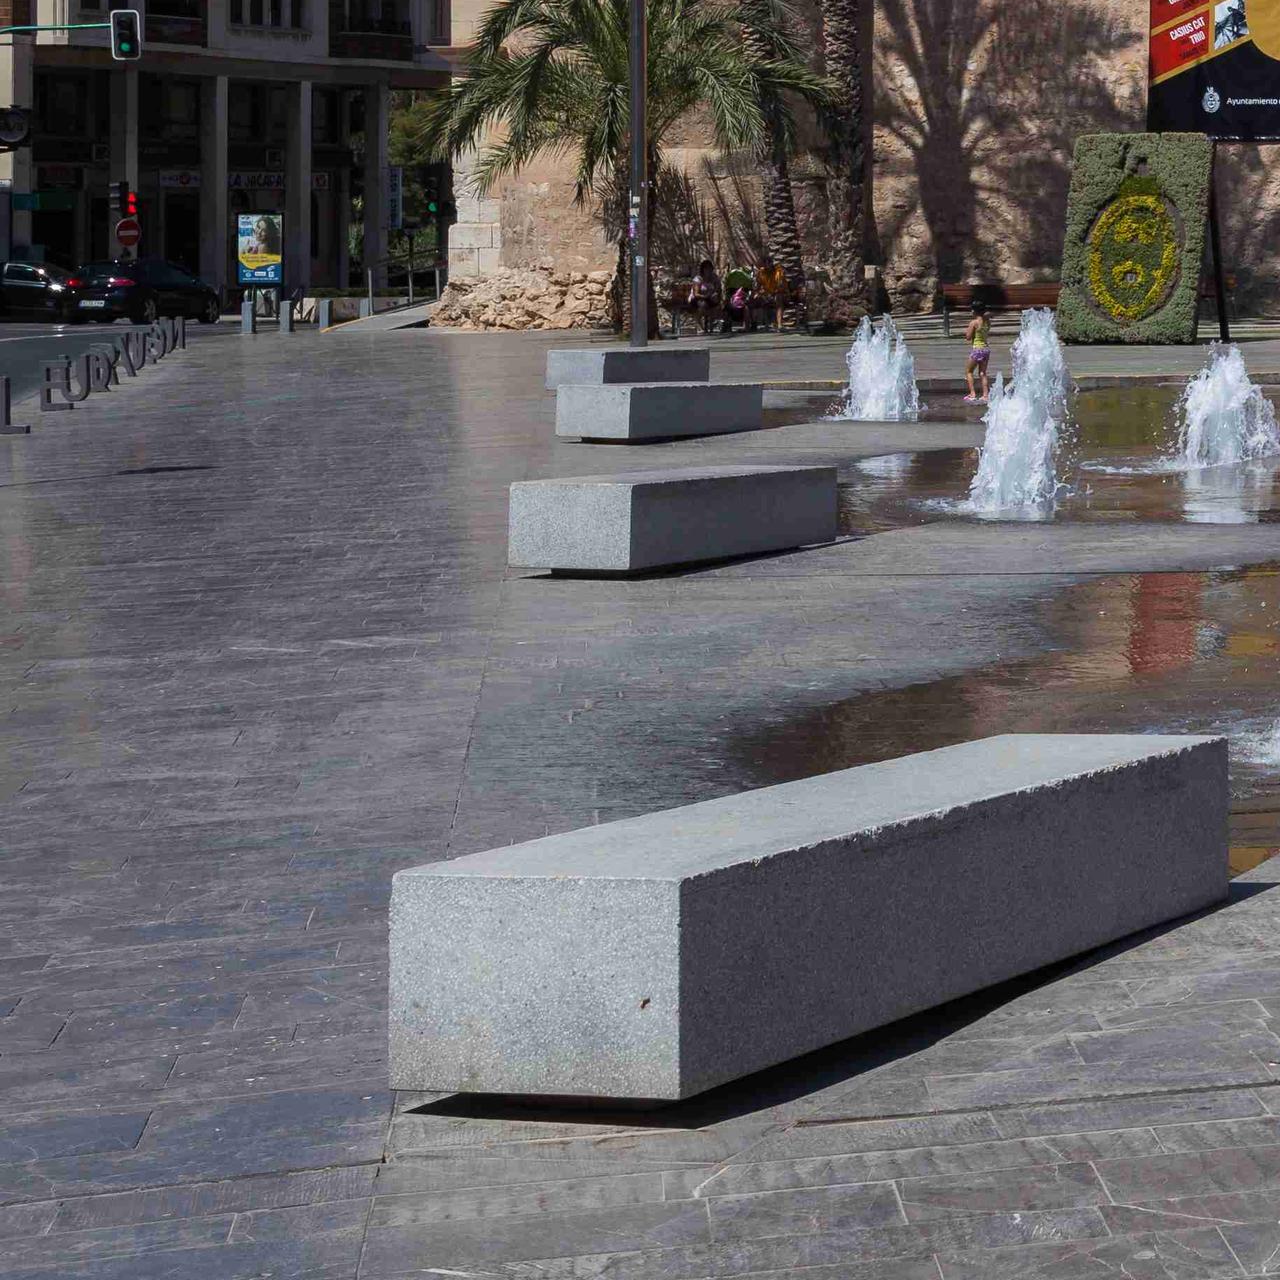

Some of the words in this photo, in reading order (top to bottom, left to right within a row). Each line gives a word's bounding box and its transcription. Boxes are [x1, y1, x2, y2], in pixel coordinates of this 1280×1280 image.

[1192, 17, 1206, 31] CAT
[1190, 30, 1206, 44] TRIO
[1226, 97, 1278, 106] Ayuntamiento
